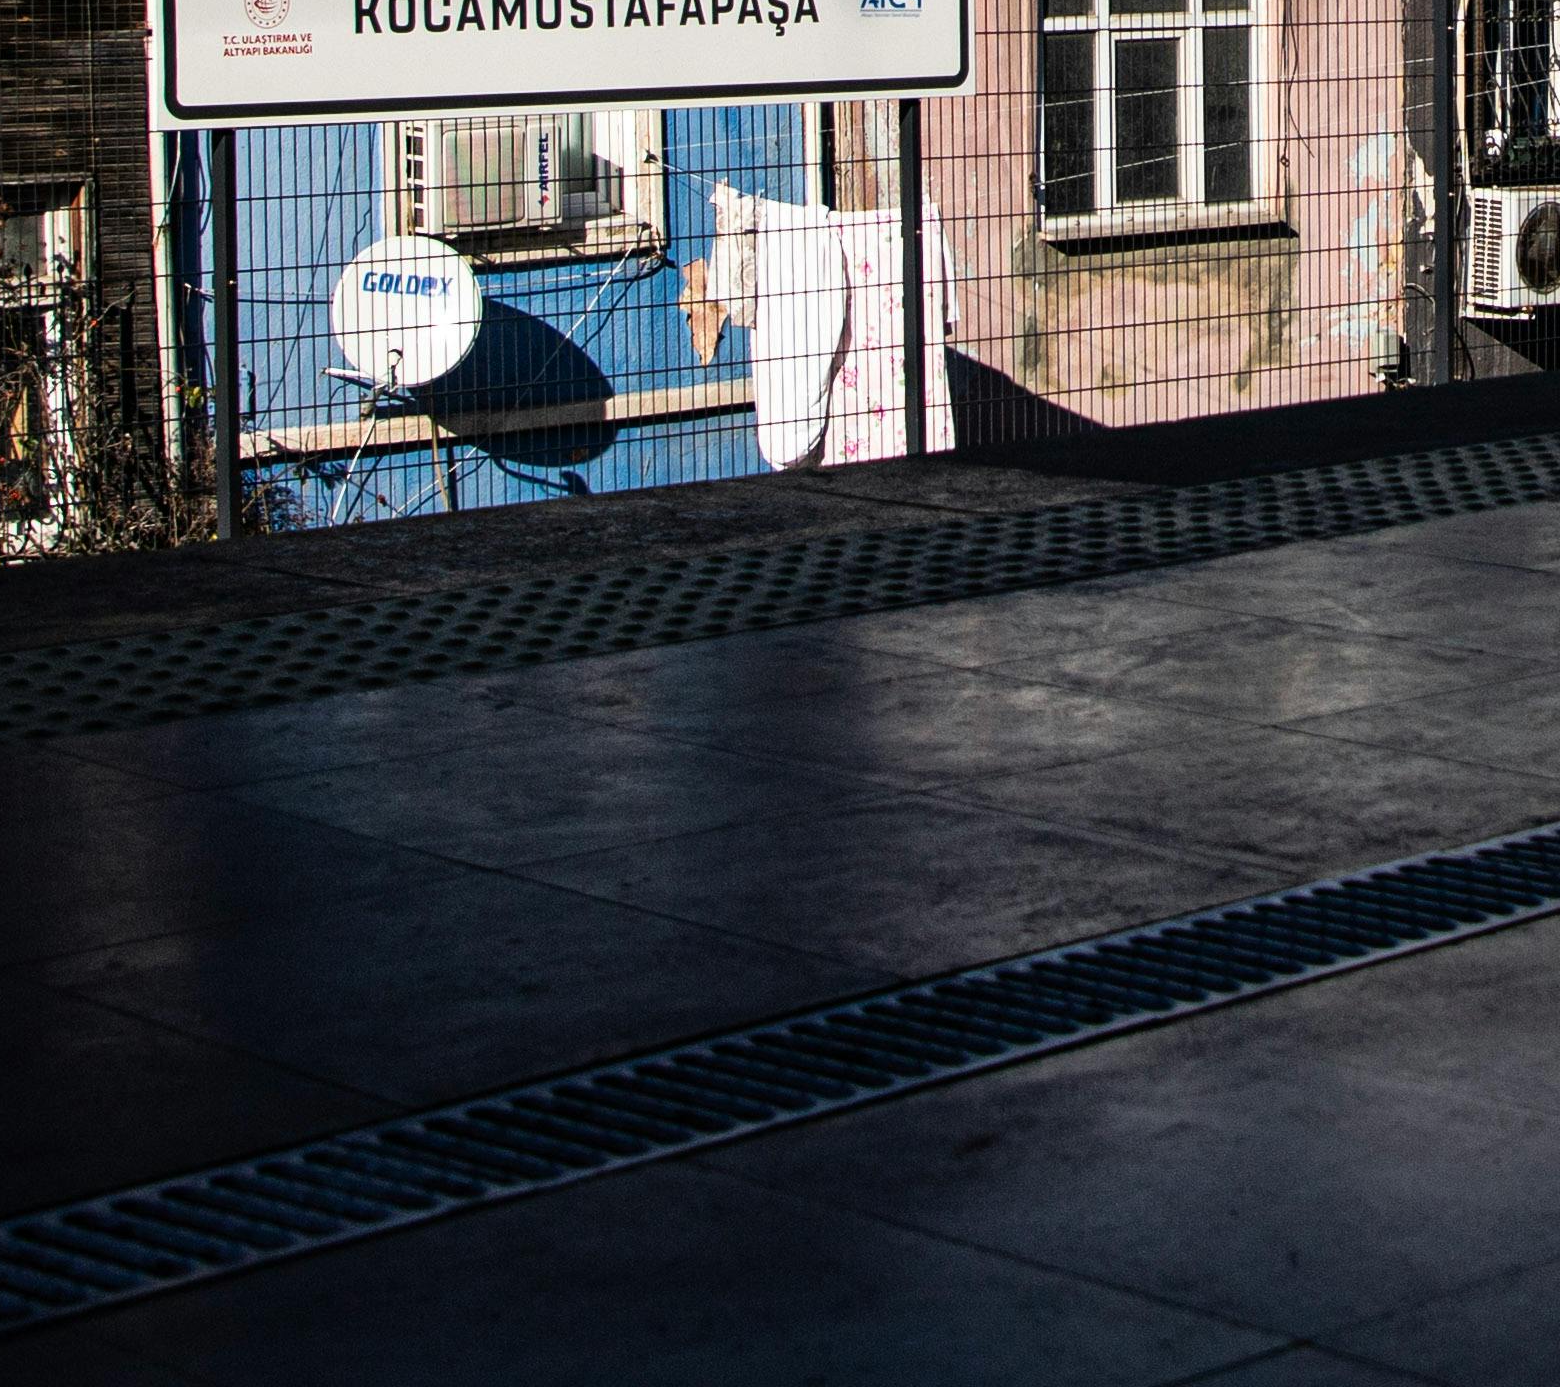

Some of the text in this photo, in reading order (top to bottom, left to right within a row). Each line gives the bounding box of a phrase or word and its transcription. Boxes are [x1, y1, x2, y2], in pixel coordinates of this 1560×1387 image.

[223, 33, 313, 45] T.C. ULAŞTIRMA VE
[223, 43, 313, 57] ALTYAPI BAKANLIĞI
[538, 132, 549, 192] AIRFEL
